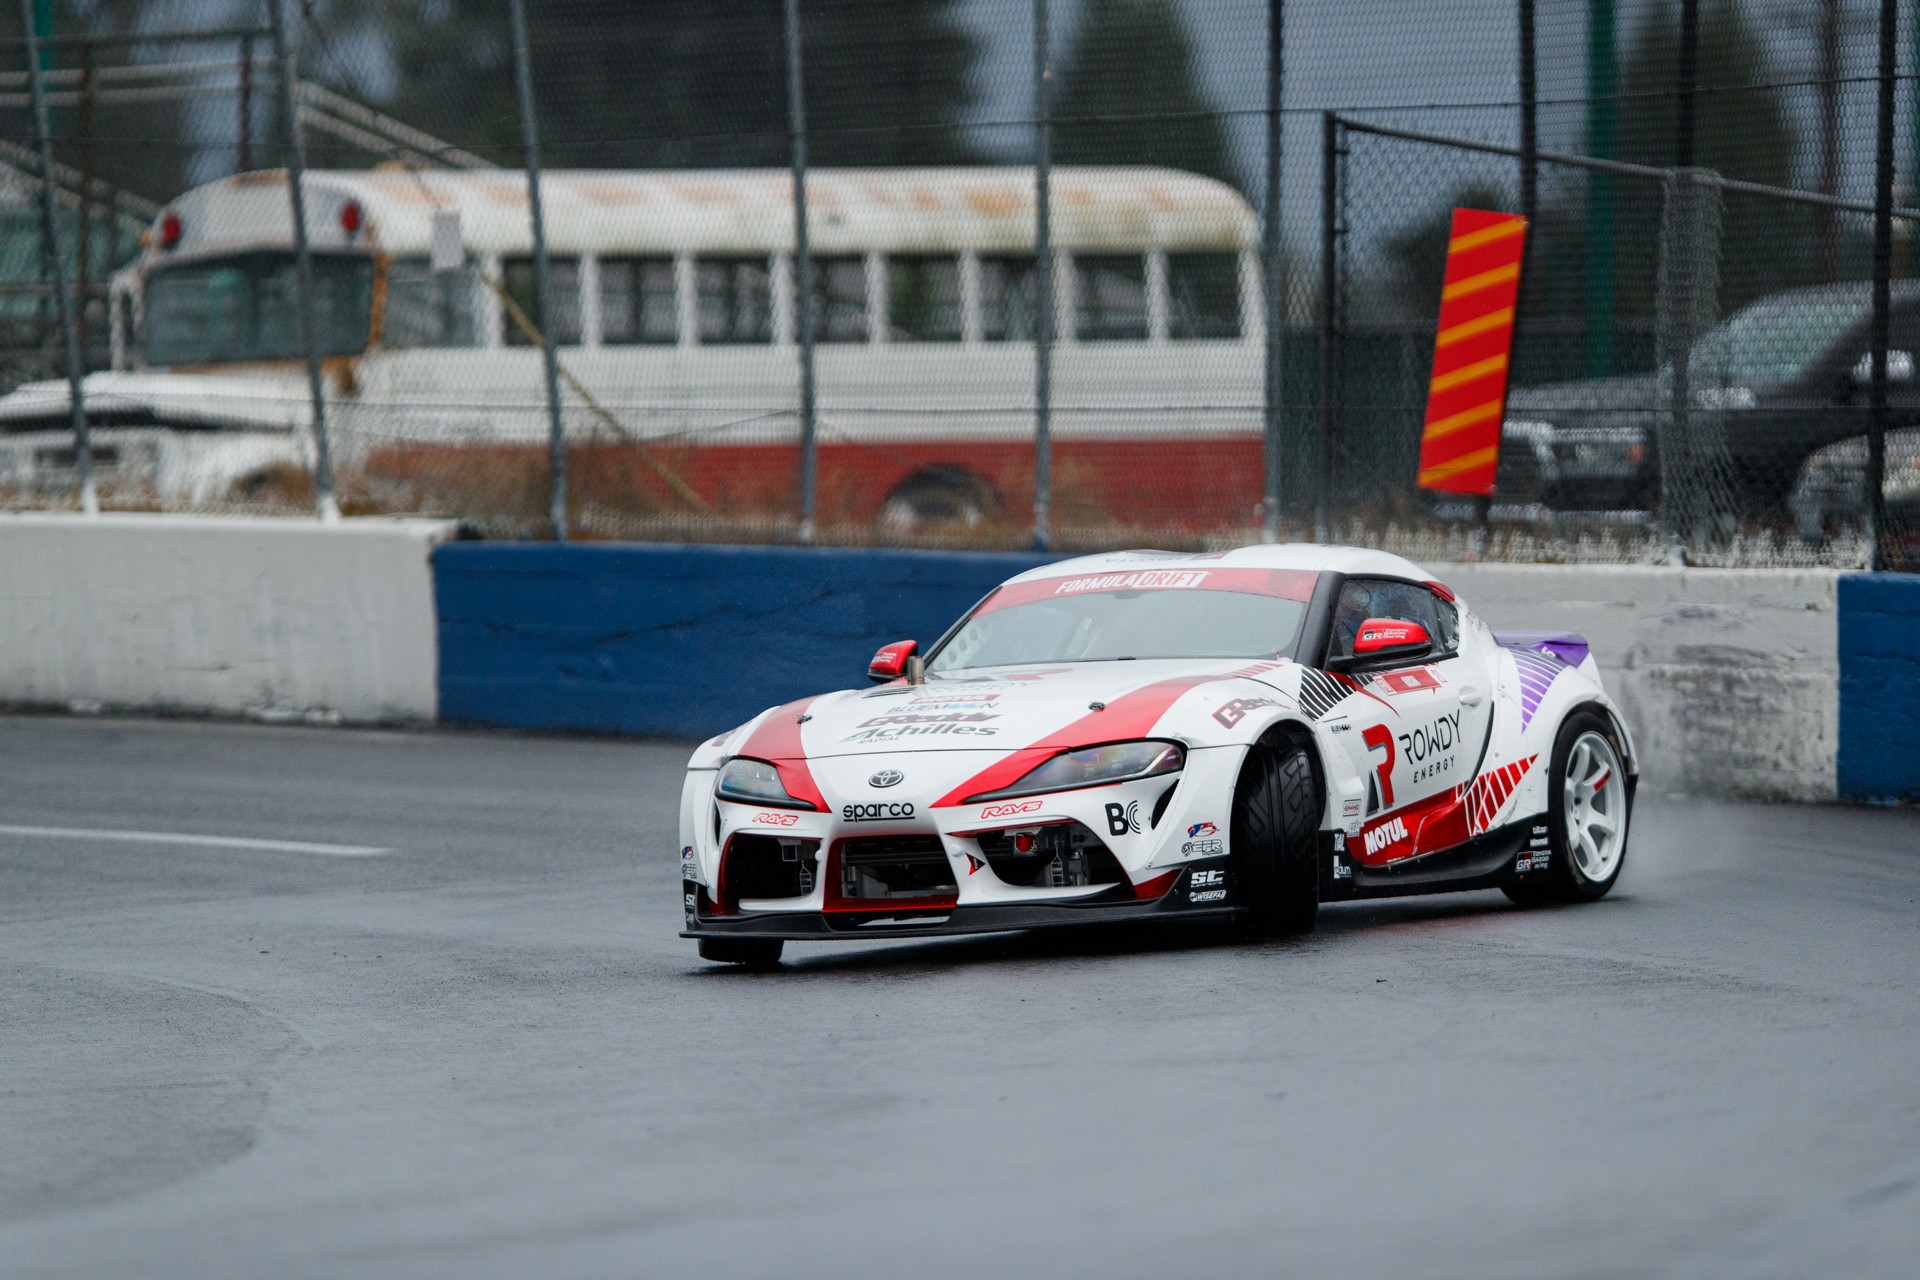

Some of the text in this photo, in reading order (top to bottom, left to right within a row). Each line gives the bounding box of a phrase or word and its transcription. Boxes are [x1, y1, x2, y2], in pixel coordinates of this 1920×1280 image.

[1055, 571, 1208, 594] FORMULA DRIFT
[840, 723, 999, 742] Achilles
[1398, 709, 1460, 765] ROWDY
[1414, 755, 1455, 783] ENERGY
[752, 813, 799, 827] RAYS
[843, 802, 915, 822] sparco
[981, 801, 1043, 819] RAYS
[1364, 816, 1408, 856] MOTUL
